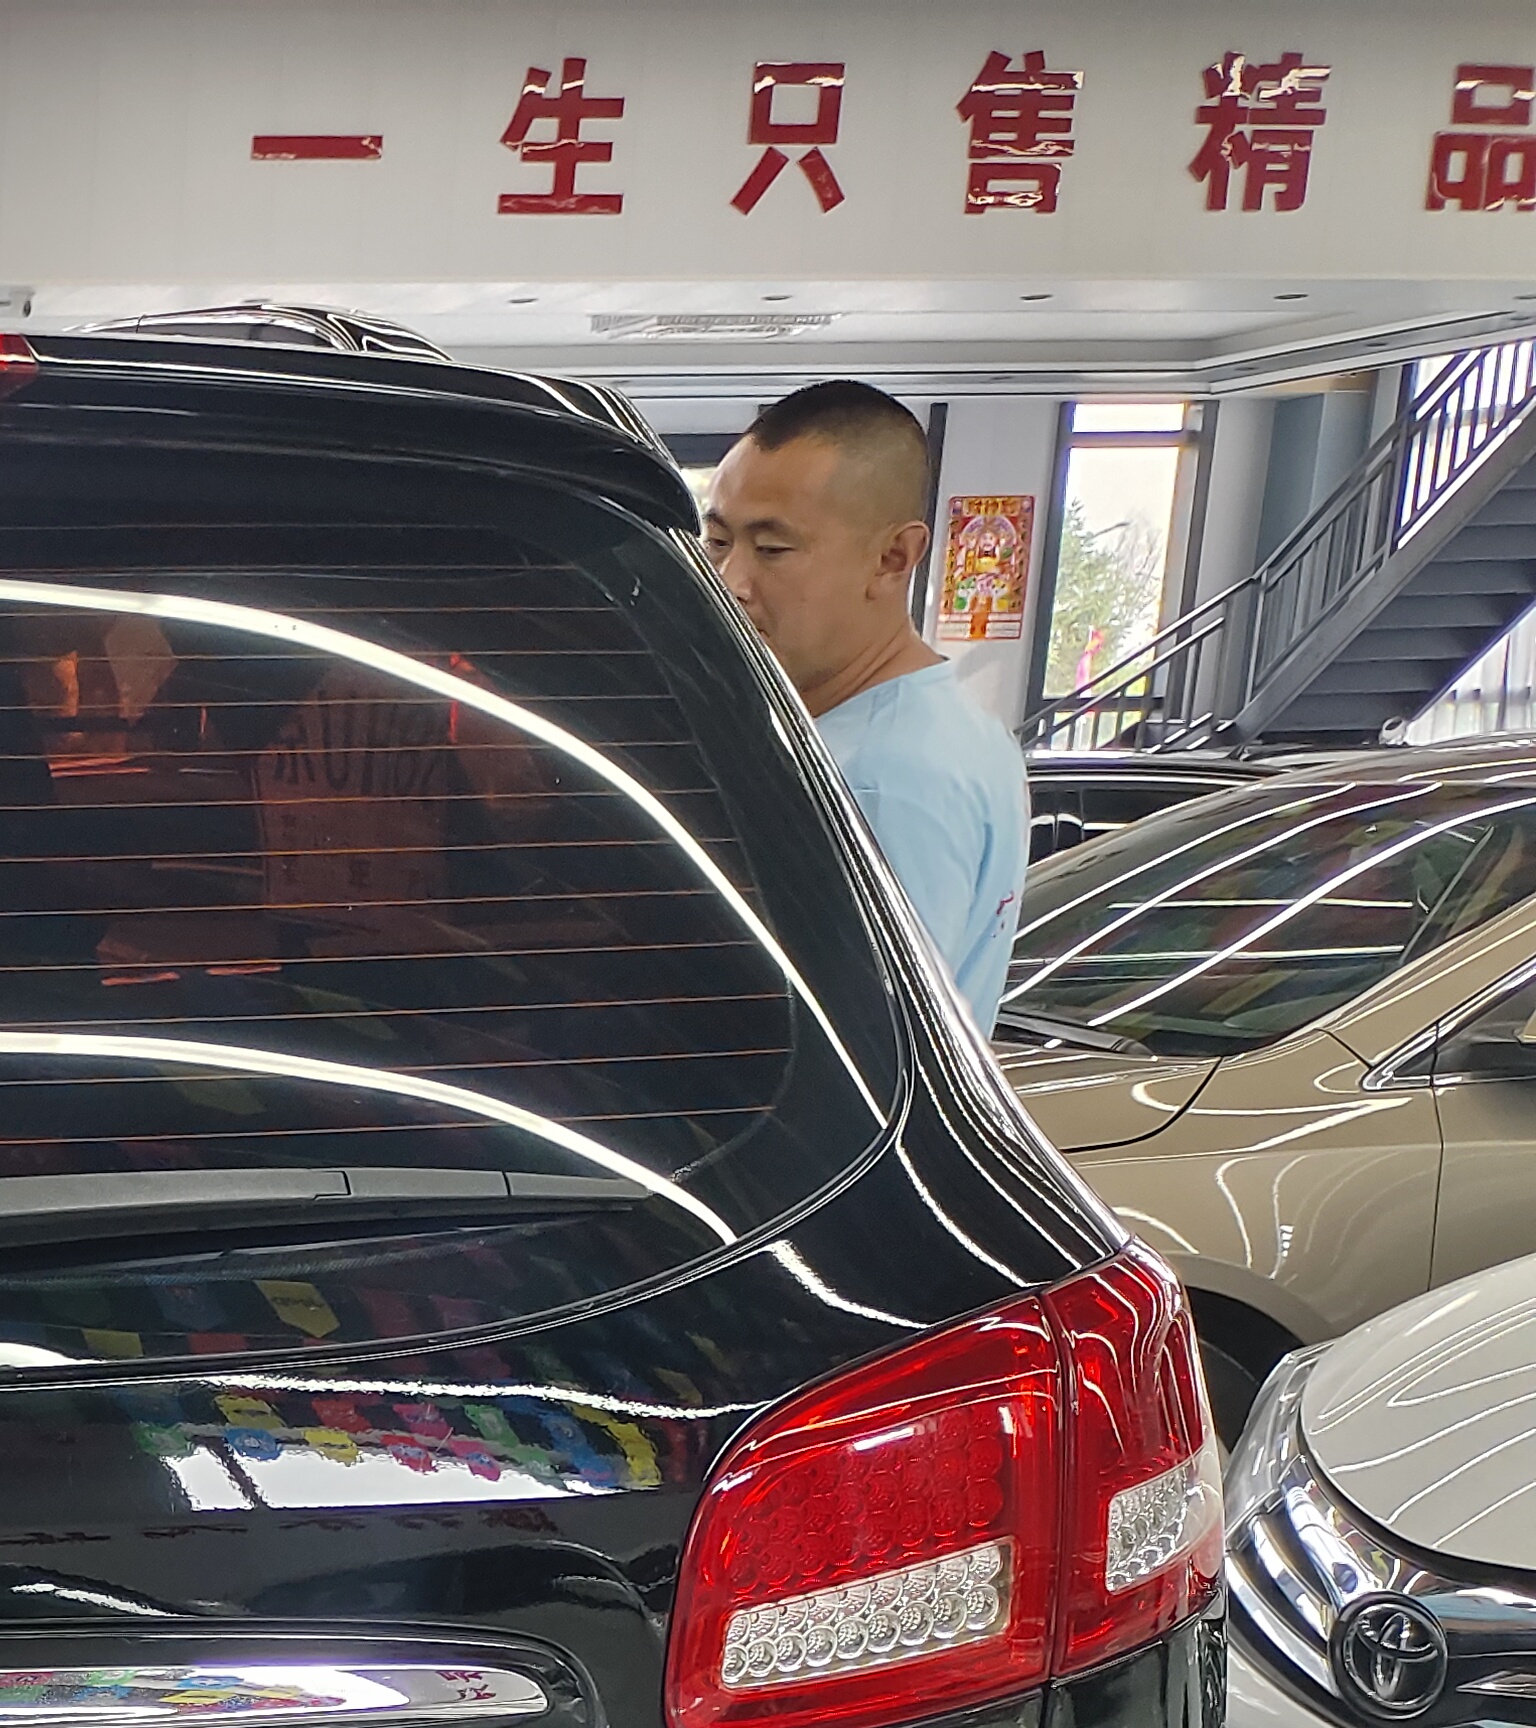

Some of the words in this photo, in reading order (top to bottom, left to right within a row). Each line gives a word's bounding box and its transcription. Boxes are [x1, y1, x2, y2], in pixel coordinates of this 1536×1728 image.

[251, 49, 1536, 216] 一生只售精品
